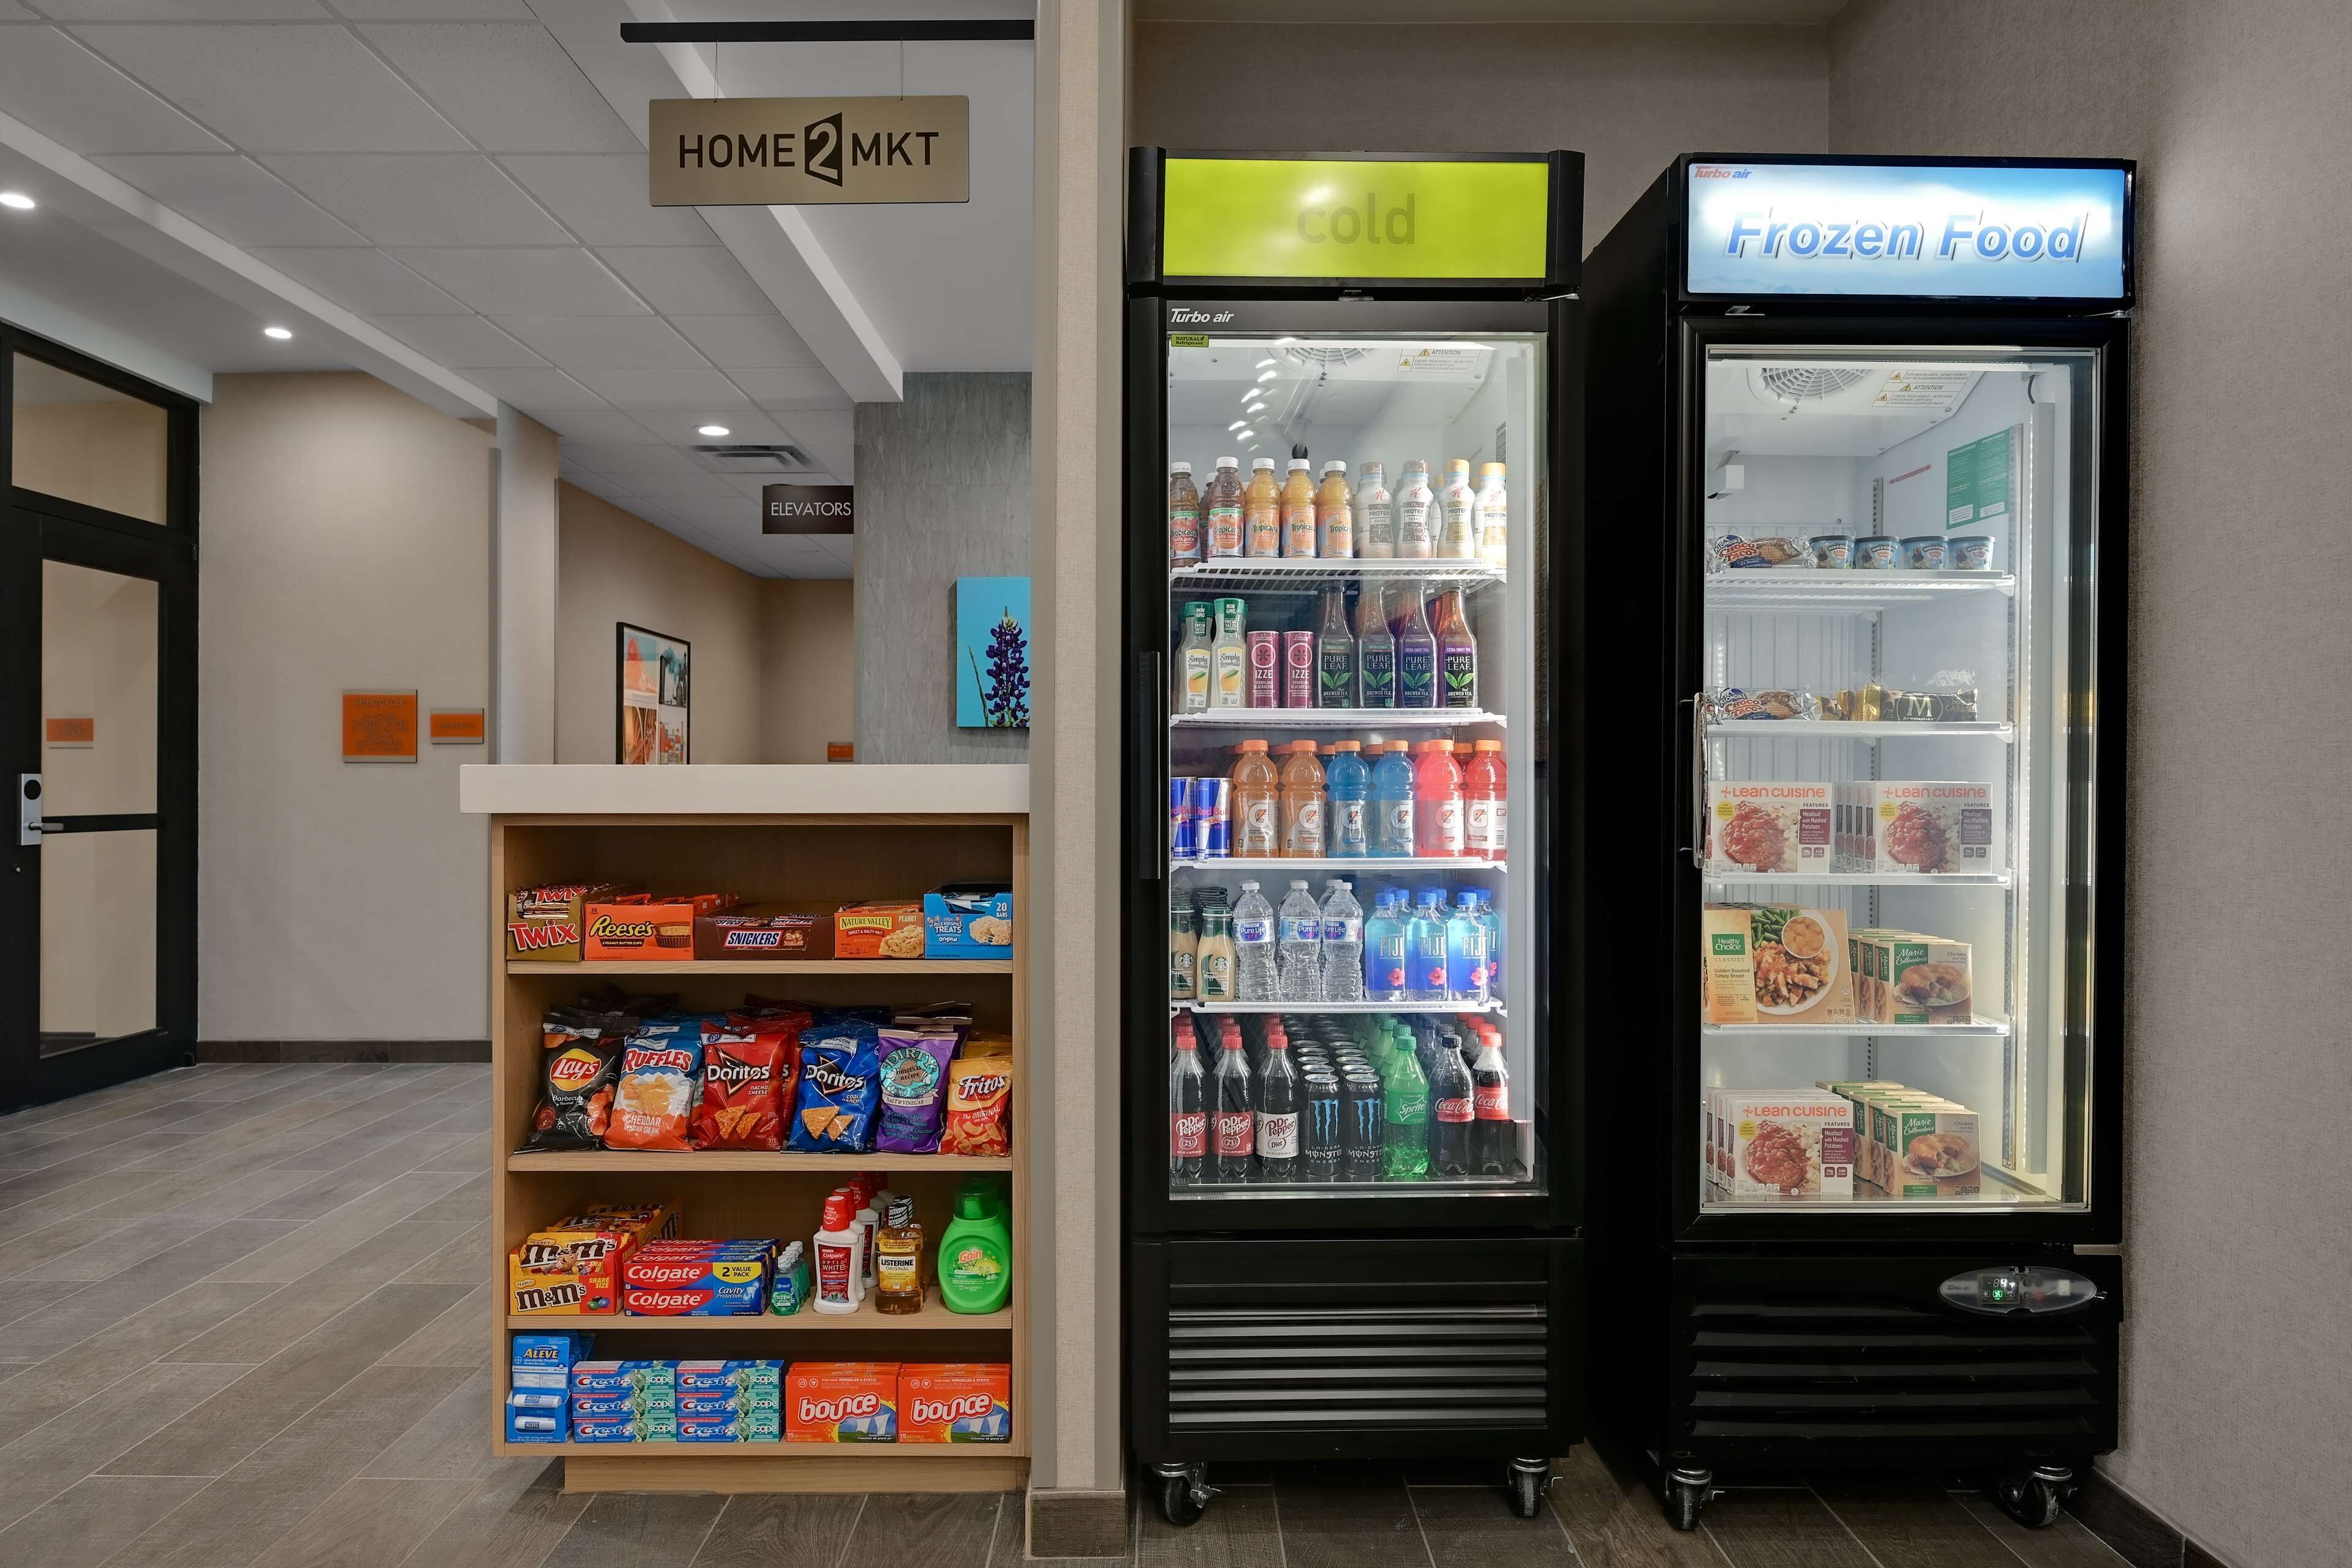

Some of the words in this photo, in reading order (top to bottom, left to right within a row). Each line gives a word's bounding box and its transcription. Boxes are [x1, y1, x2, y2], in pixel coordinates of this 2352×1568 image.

[1694, 166, 1731, 178] Turbo
[1732, 169, 1752, 178] air
[1297, 192, 1415, 245] cold
[1727, 211, 1923, 258] Frozen
[1937, 212, 2086, 260] Food
[1170, 308, 1210, 323] Turbo
[1213, 311, 1234, 323] air
[771, 502, 851, 516] ELEVATORS
[1714, 537, 1742, 554] KLONDIKE
[1719, 543, 1755, 558] CHOCO
[1188, 655, 1208, 665] Simply
[1220, 653, 1240, 663] Simply
[1256, 670, 1273, 679] IZZE
[1292, 670, 1309, 679] IZZE
[1719, 693, 1747, 707] KLONDIKE
[1725, 699, 1760, 714] CHOCO
[1907, 696, 1932, 717] M
[1197, 807, 1212, 816] Red
[1214, 807, 1231, 816] Bull
[997, 903, 1007, 912] 20
[842, 918, 866, 929] NATURE
[867, 918, 891, 928] VALLEY
[728, 932, 779, 945] SNICKERS
[1380, 937, 1404, 956] FIJI
[1420, 937, 1446, 956] FIJI
[1462, 937, 1487, 956] FIJI
[1897, 948, 1925, 959] Marie
[1896, 956, 1928, 966] Callender's
[622, 1050, 692, 1072] RUFFLES
[552, 1058, 599, 1080] Lay's
[708, 1065, 771, 1081] Doritos
[896, 1065, 922, 1075] ORIGINAL
[805, 1065, 864, 1088] Doritos
[959, 1074, 1006, 1099] Fritos
[973, 1105, 1001, 1119] ORIGINAL
[1399, 1103, 1426, 1114] Sprite
[1434, 1098, 1474, 1114] Coca-Cola
[627, 1115, 661, 1126] CHEDDAR
[1187, 1116, 1199, 1126] Dr
[1230, 1116, 1243, 1126] Dr
[1276, 1118, 1289, 1128] Dr
[1905, 1118, 1932, 1128] Marie
[1177, 1119, 1205, 1136] Pepper
[1220, 1120, 1250, 1136] Pepper
[1267, 1121, 1294, 1139] Pepper
[1904, 1126, 1934, 1136] Callender's
[960, 1251, 982, 1263] Gain
[627, 1265, 700, 1283] Colgate
[722, 1267, 730, 1277] 2
[718, 1286, 744, 1295] Cavity
[628, 1292, 701, 1309] Colgate
[523, 1349, 559, 1359] ALEVE
[578, 1377, 620, 1386] Crest
[646, 1376, 673, 1384] scope
[682, 1376, 724, 1385] Crest
[750, 1376, 777, 1384] scope
[578, 1401, 621, 1411] Crest
[646, 1400, 673, 1409] scope
[682, 1401, 724, 1410] Crest
[750, 1400, 777, 1409] scope
[800, 1395, 876, 1420] bounce
[913, 1395, 990, 1422] bounce
[580, 1426, 623, 1435] Crest
[648, 1425, 676, 1434] scope
[682, 1426, 724, 1435] Crest
[750, 1425, 777, 1434] scope
